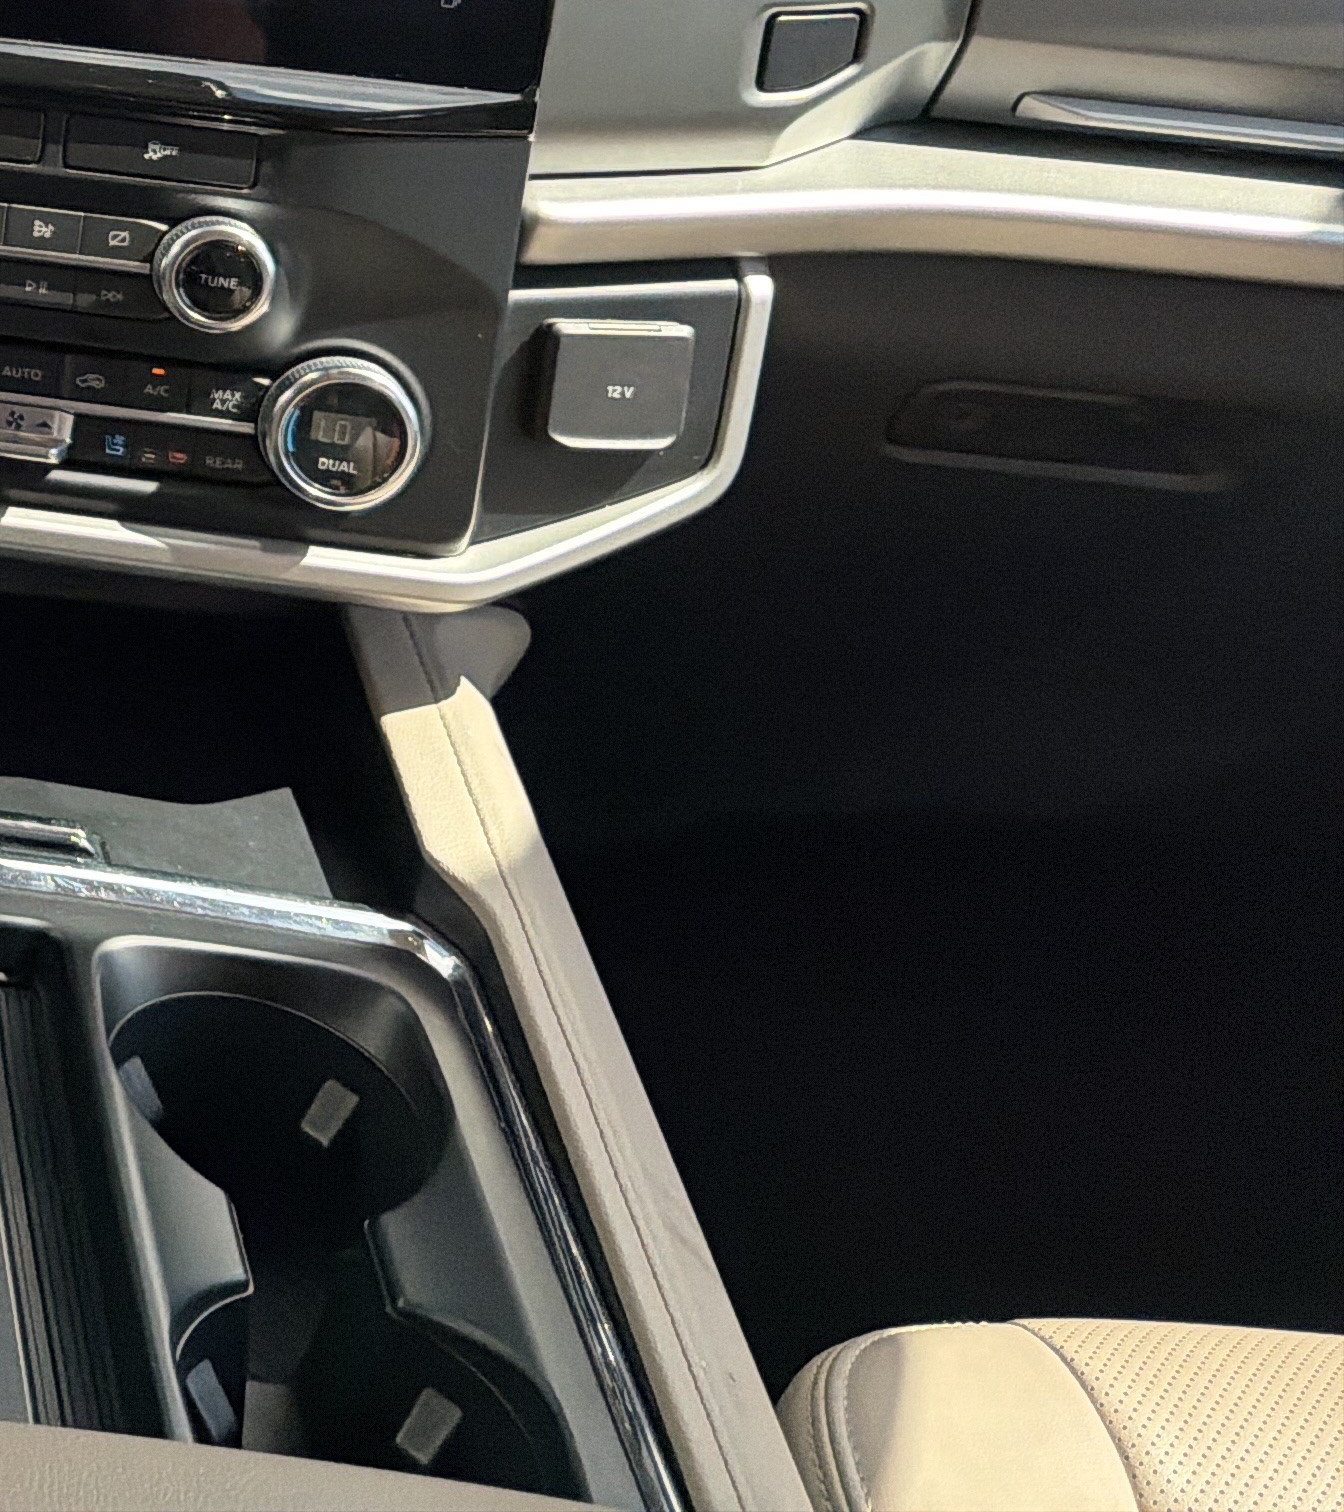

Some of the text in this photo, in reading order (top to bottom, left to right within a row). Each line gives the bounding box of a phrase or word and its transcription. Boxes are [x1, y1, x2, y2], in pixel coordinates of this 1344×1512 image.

[199, 274, 240, 290] TUNE
[2, 365, 43, 381] AUTO
[143, 384, 170, 397] A/C
[210, 388, 242, 402] MAX
[212, 399, 240, 413] A/C
[205, 454, 243, 470] REAR
[317, 457, 359, 475] DUAL
